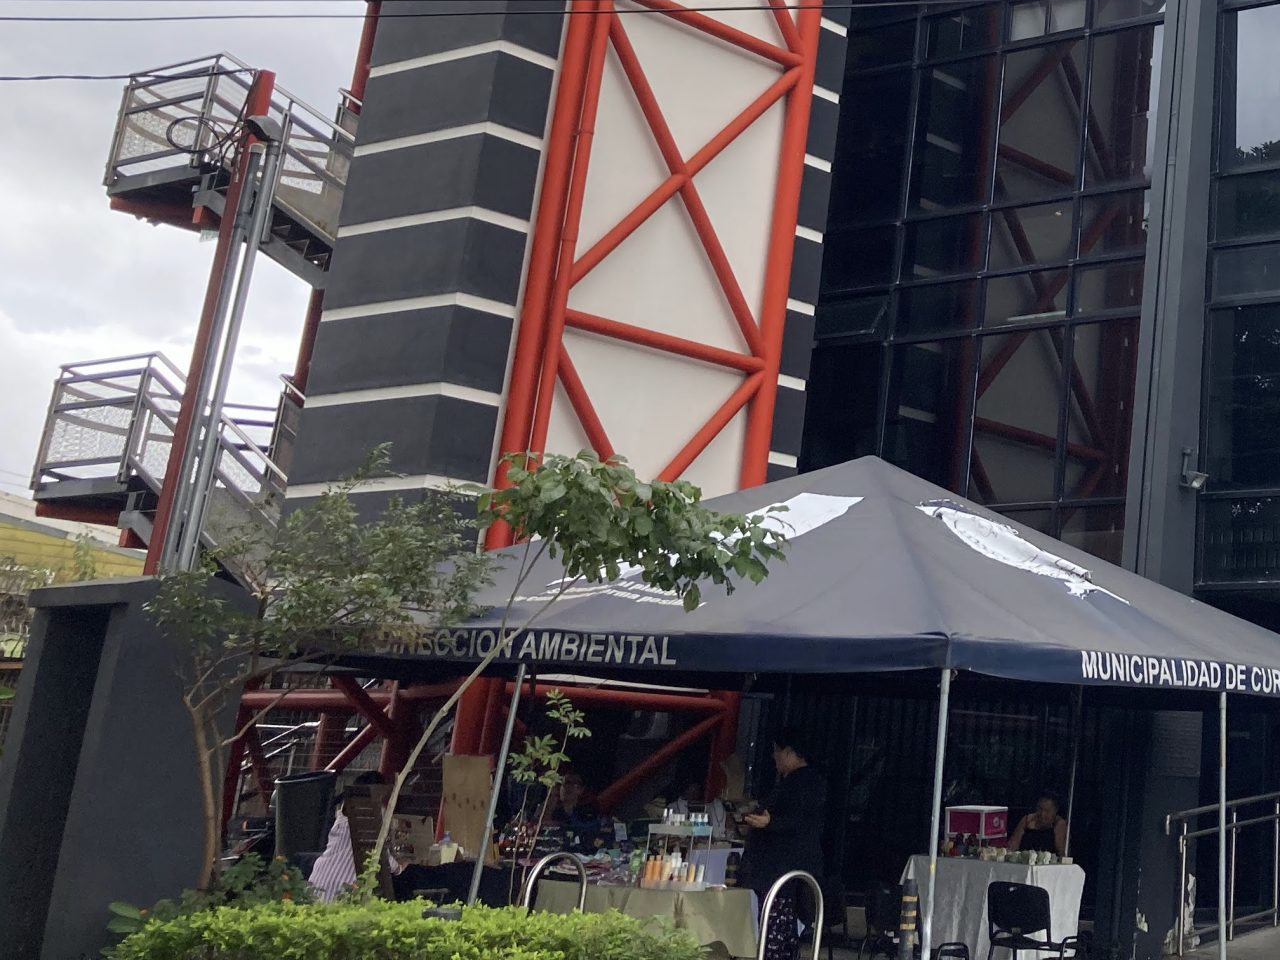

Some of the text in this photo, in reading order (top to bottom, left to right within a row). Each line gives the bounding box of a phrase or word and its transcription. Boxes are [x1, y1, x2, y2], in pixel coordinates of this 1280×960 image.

[518, 631, 677, 665] AMBIENTAL
[1081, 650, 1221, 689] MUNICIPALIDAD
[1225, 663, 1247, 691] DE
